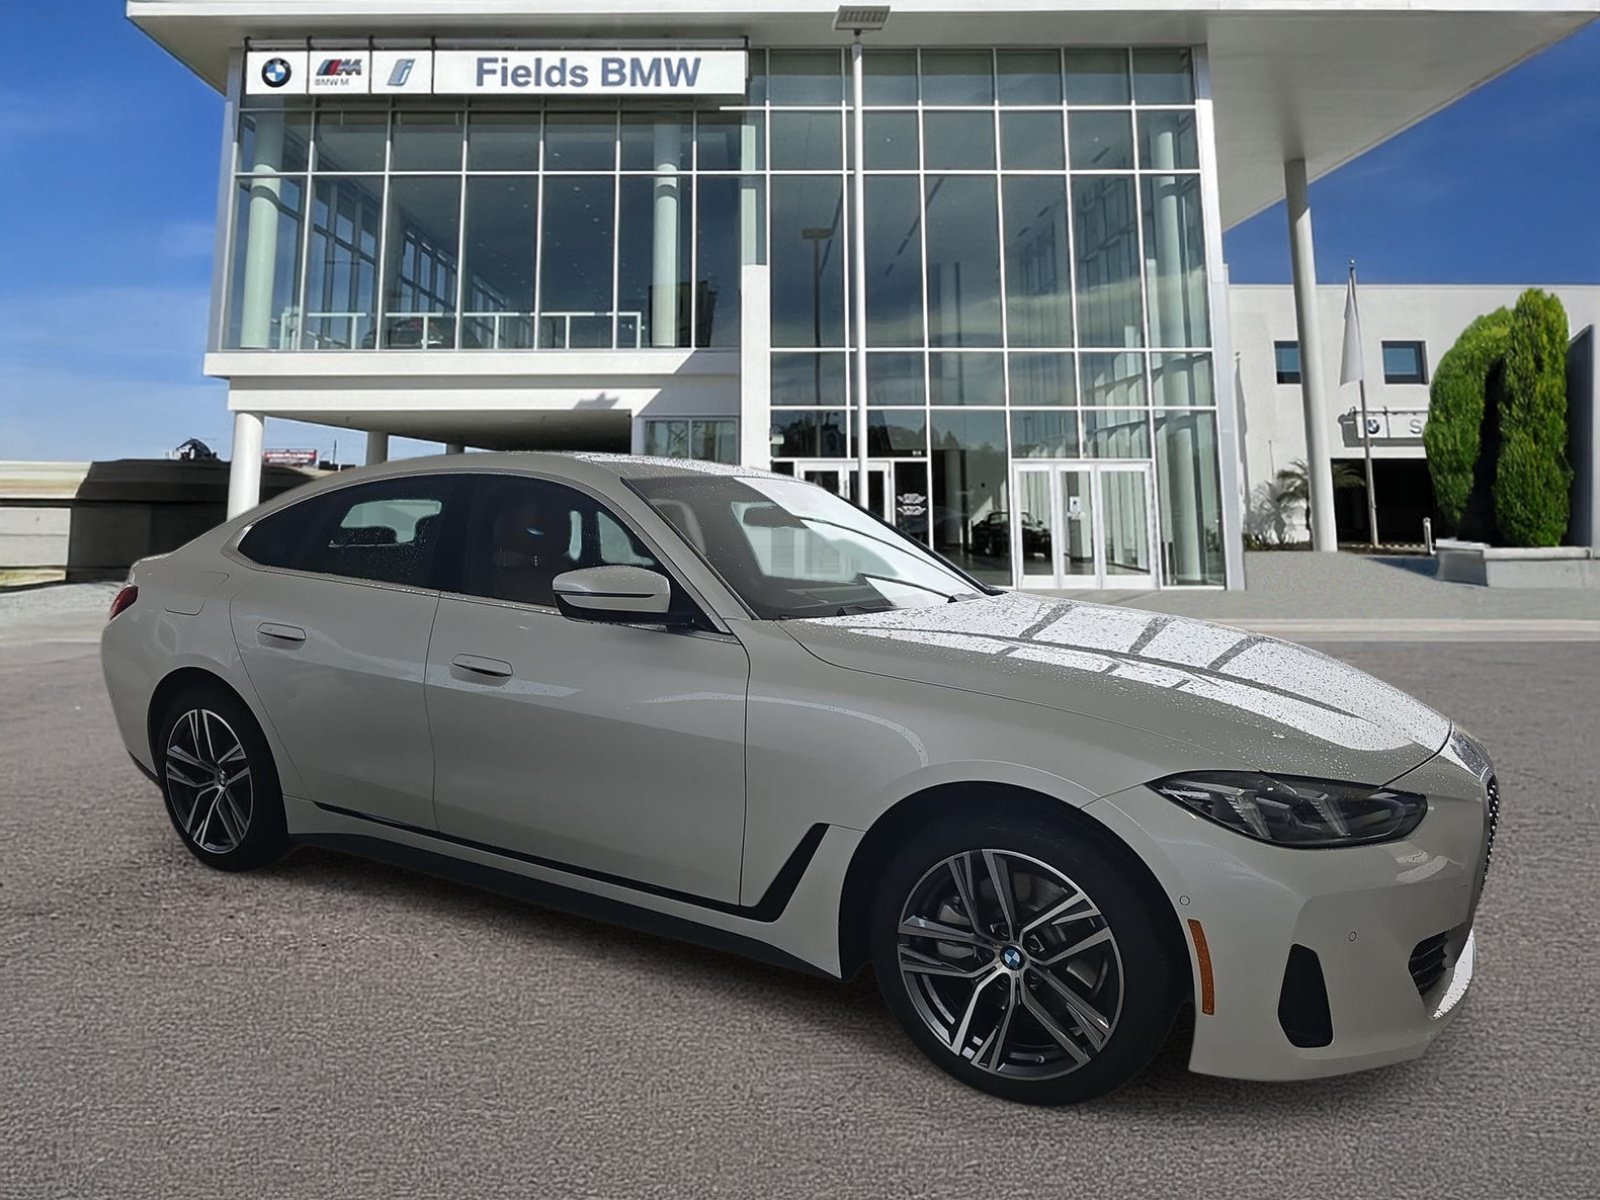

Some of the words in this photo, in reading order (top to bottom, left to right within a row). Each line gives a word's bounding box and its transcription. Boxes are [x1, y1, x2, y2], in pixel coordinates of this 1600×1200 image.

[476, 57, 589, 87] Fields
[601, 57, 702, 87] BMW
[314, 78, 339, 86] BMW
